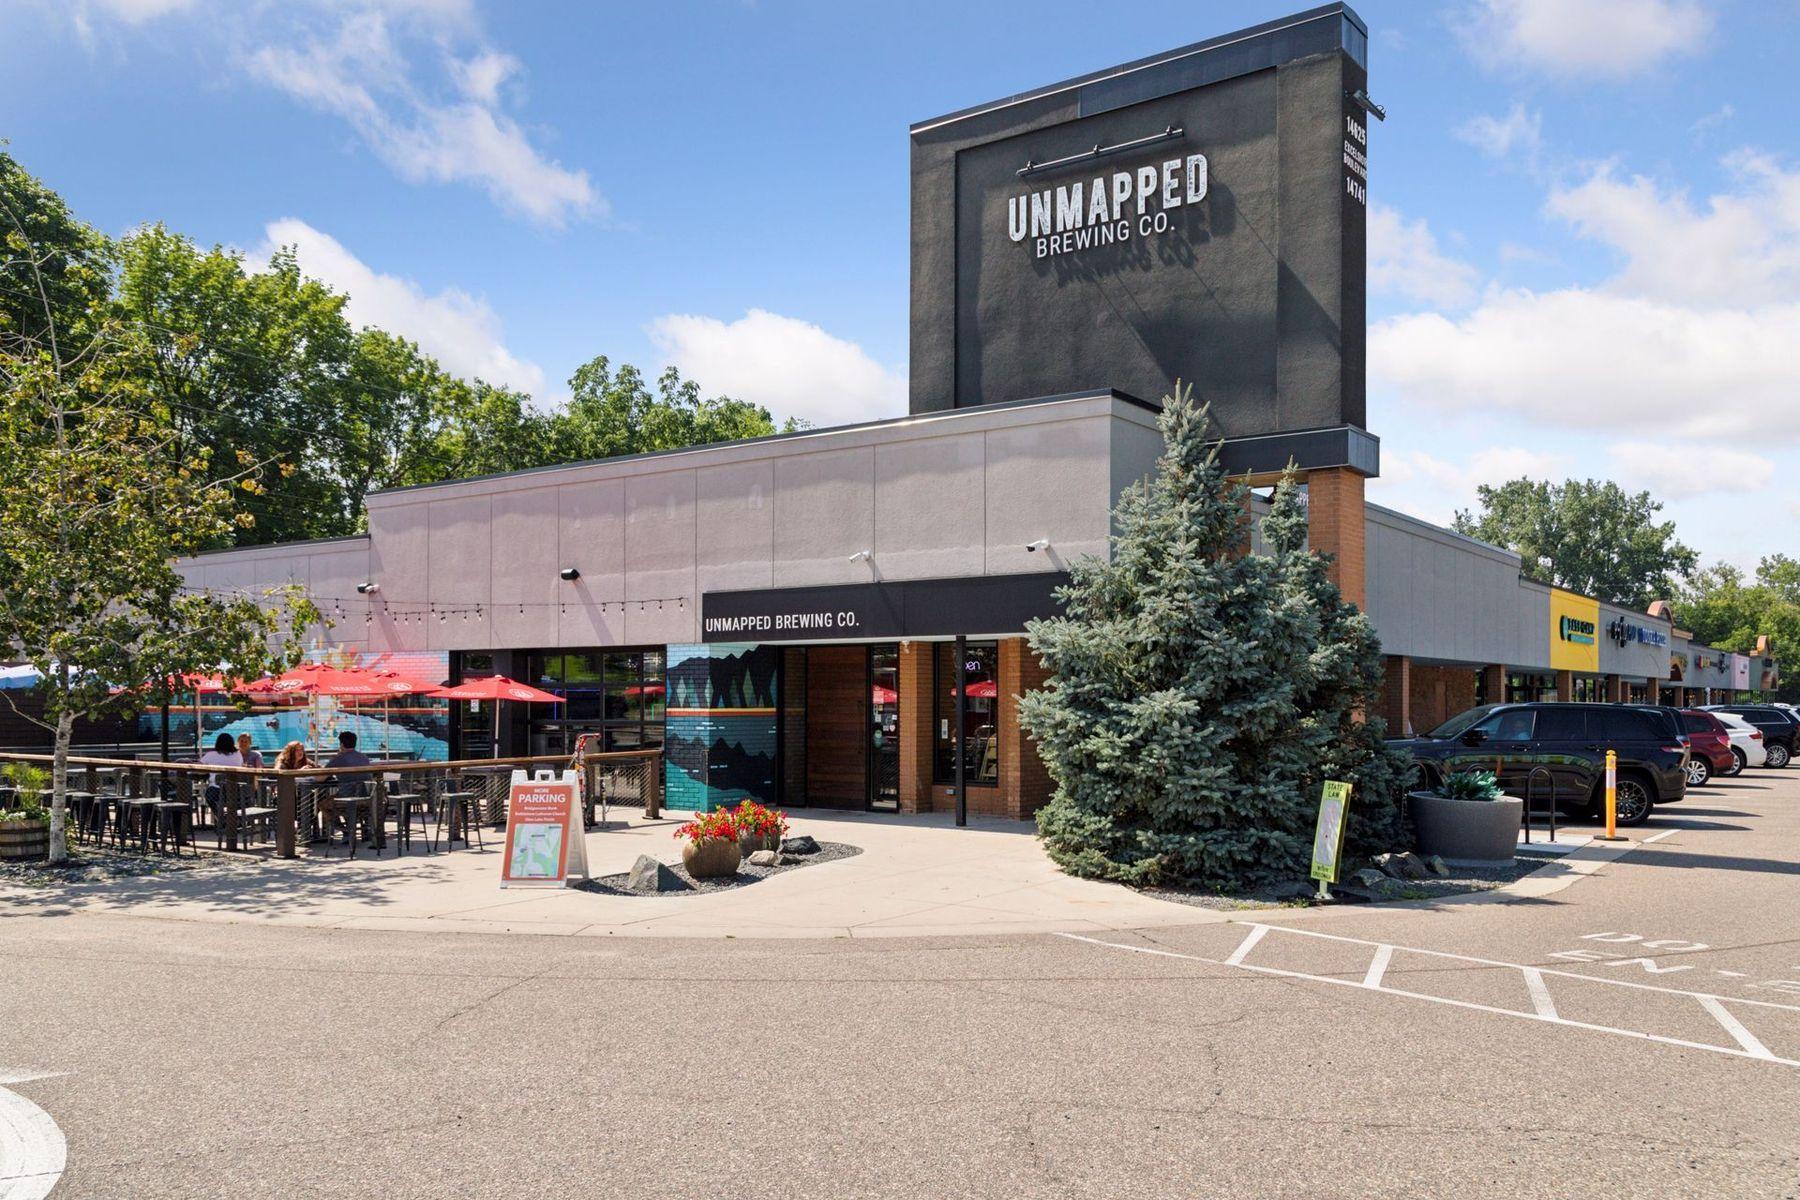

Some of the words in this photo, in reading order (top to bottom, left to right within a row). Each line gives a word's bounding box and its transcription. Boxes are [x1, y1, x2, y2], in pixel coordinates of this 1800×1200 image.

[1346, 116, 1365, 146] 14625
[1009, 154, 1208, 241] UNMAPPED
[1346, 177, 1365, 205] 14741
[1037, 220, 1130, 258] BREWING
[1138, 212, 1175, 237] CO.
[705, 615, 771, 632] UNMAPPED
[775, 612, 833, 629] BREWING
[837, 611, 860, 627] CO.
[518, 793, 566, 803] PARKING
